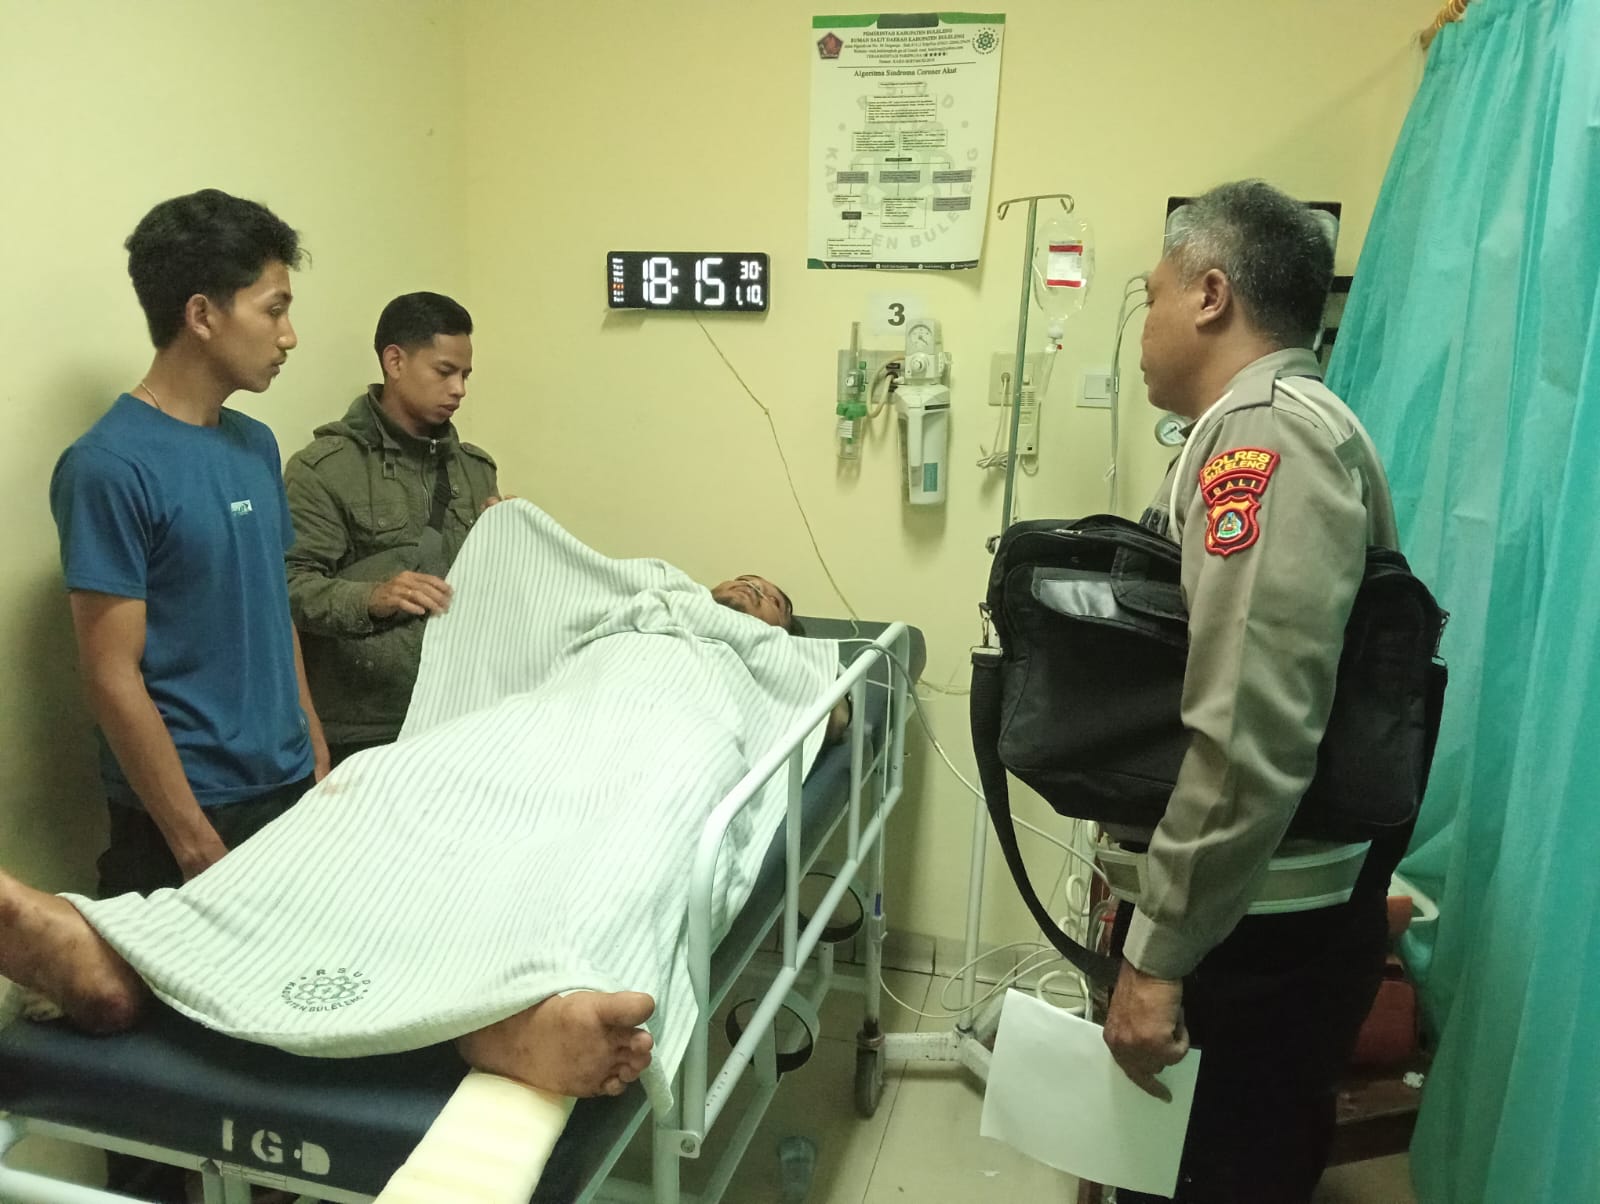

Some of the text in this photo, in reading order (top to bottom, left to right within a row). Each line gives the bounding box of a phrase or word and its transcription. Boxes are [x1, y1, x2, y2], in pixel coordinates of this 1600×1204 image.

[942, 66, 957, 74] Akut
[642, 257, 725, 306] 18:15
[887, 303, 906, 326] 3
[1202, 450, 1272, 476] POLRES
[1212, 479, 1257, 496] BALI
[316, 967, 372, 985] RSUD
